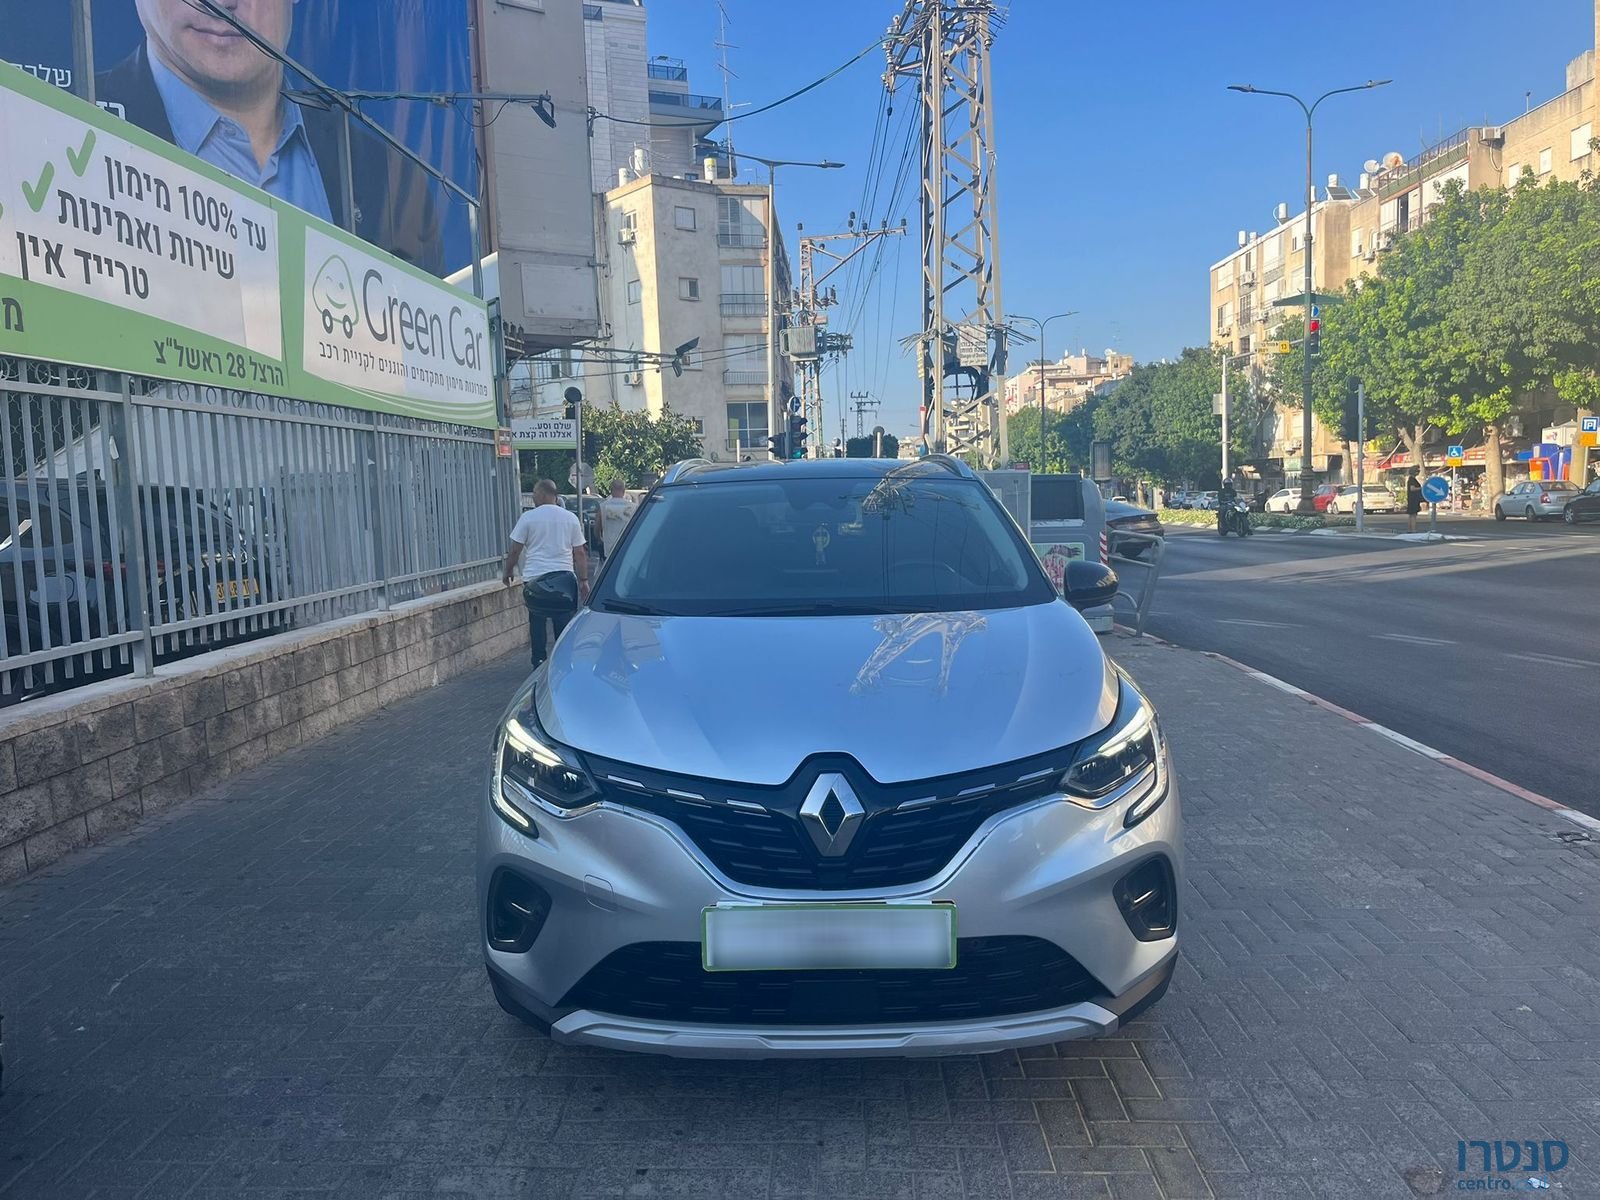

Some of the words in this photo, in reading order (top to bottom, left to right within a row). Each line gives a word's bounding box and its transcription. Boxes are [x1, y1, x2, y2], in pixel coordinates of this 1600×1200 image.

[104, 155, 171, 213] מימון
[57, 189, 162, 256] ואמינות
[178, 185, 238, 240] 100%
[242, 217, 267, 252] עד
[16, 231, 66, 280] אין
[169, 230, 235, 280] שירות
[74, 248, 150, 300] טרייד
[363, 268, 445, 360] Green
[449, 306, 483, 371] Car
[319, 341, 340, 361] רכב
[342, 347, 376, 372] לקניית
[226, 352, 247, 379] 28
[249, 355, 284, 387] הרצל
[378, 357, 409, 378] והוגנים
[411, 366, 445, 388] מתקדמים
[445, 375, 464, 392] מימון
[464, 379, 489, 397] פתרונות
[519, 431, 537, 440] קצת
[550, 430, 572, 438] אצלנו
[553, 422, 571, 430] שלם
